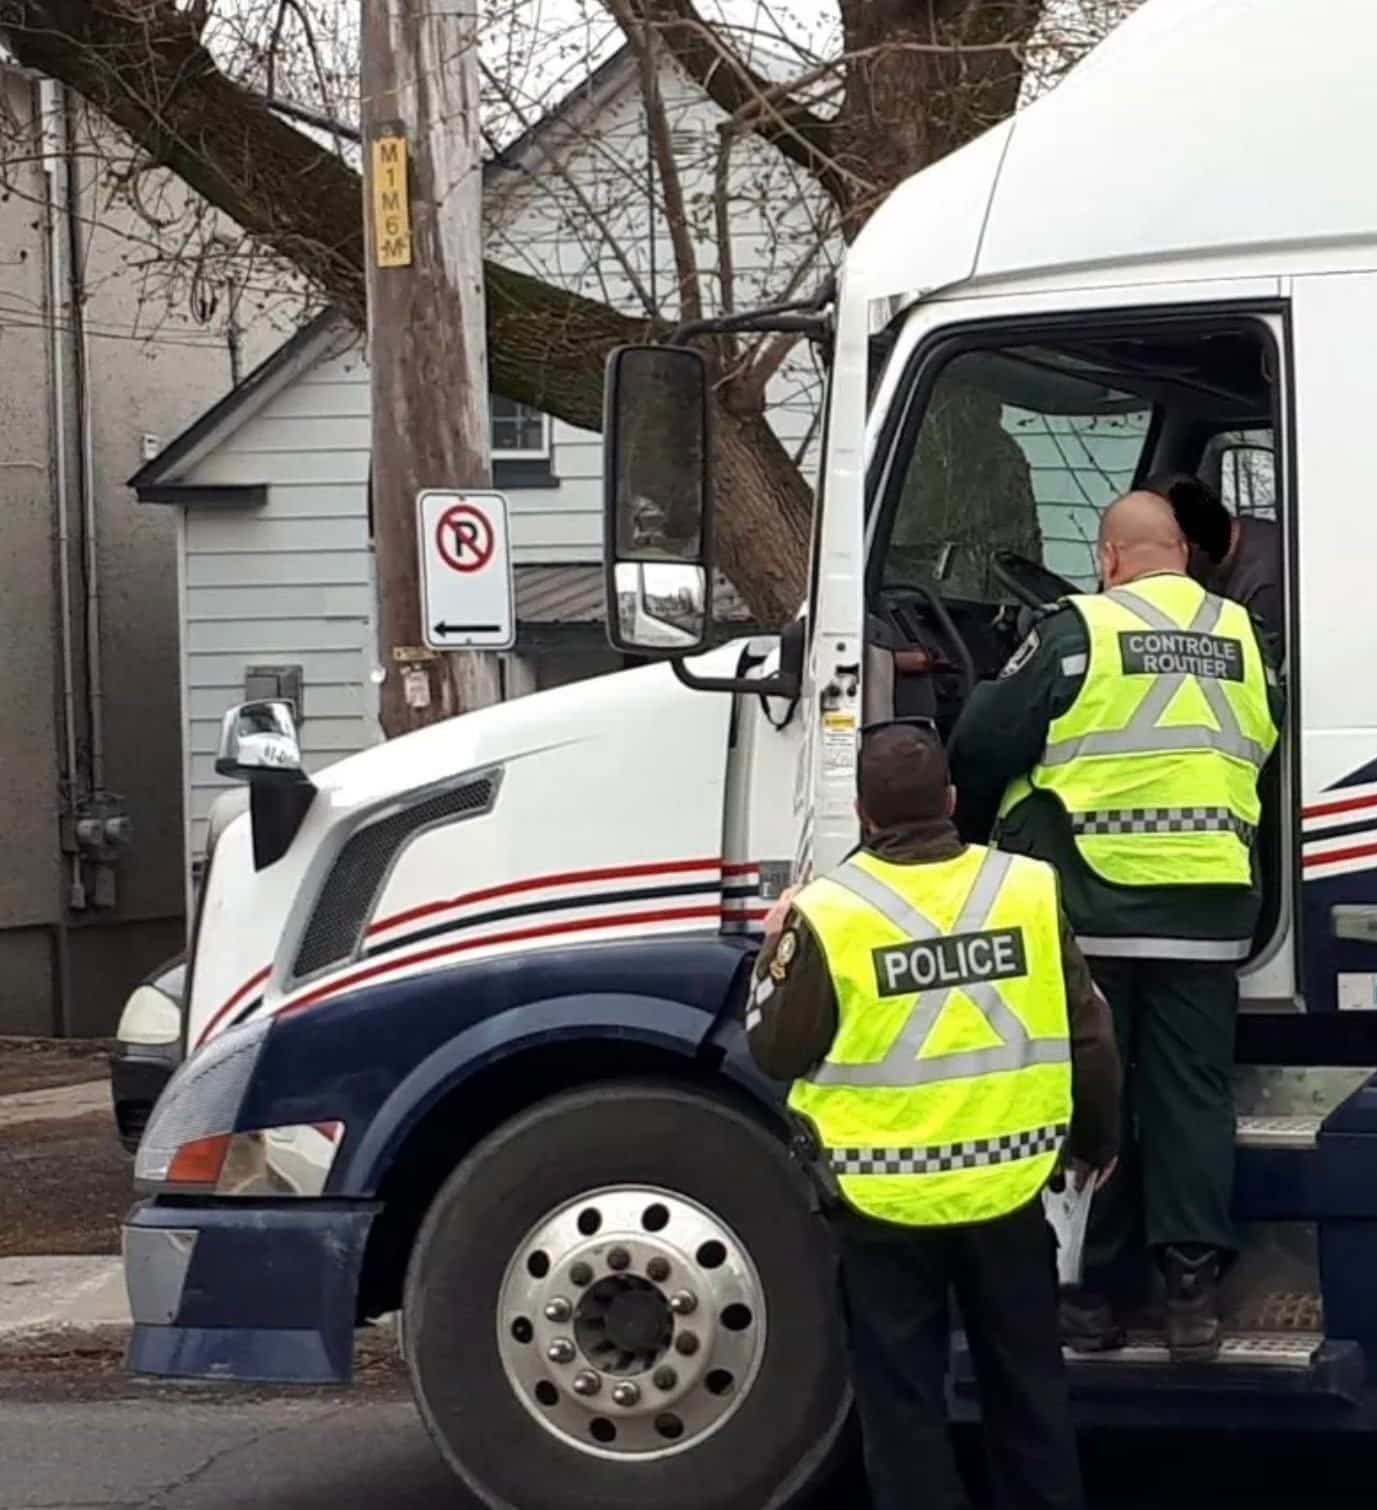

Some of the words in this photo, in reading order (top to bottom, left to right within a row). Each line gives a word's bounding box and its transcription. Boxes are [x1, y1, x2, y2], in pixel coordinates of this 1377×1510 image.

[1129, 635, 1236, 659] CONTRÔLE
[1144, 654, 1227, 677] ROUTIER
[884, 935, 1016, 989] POLICE
